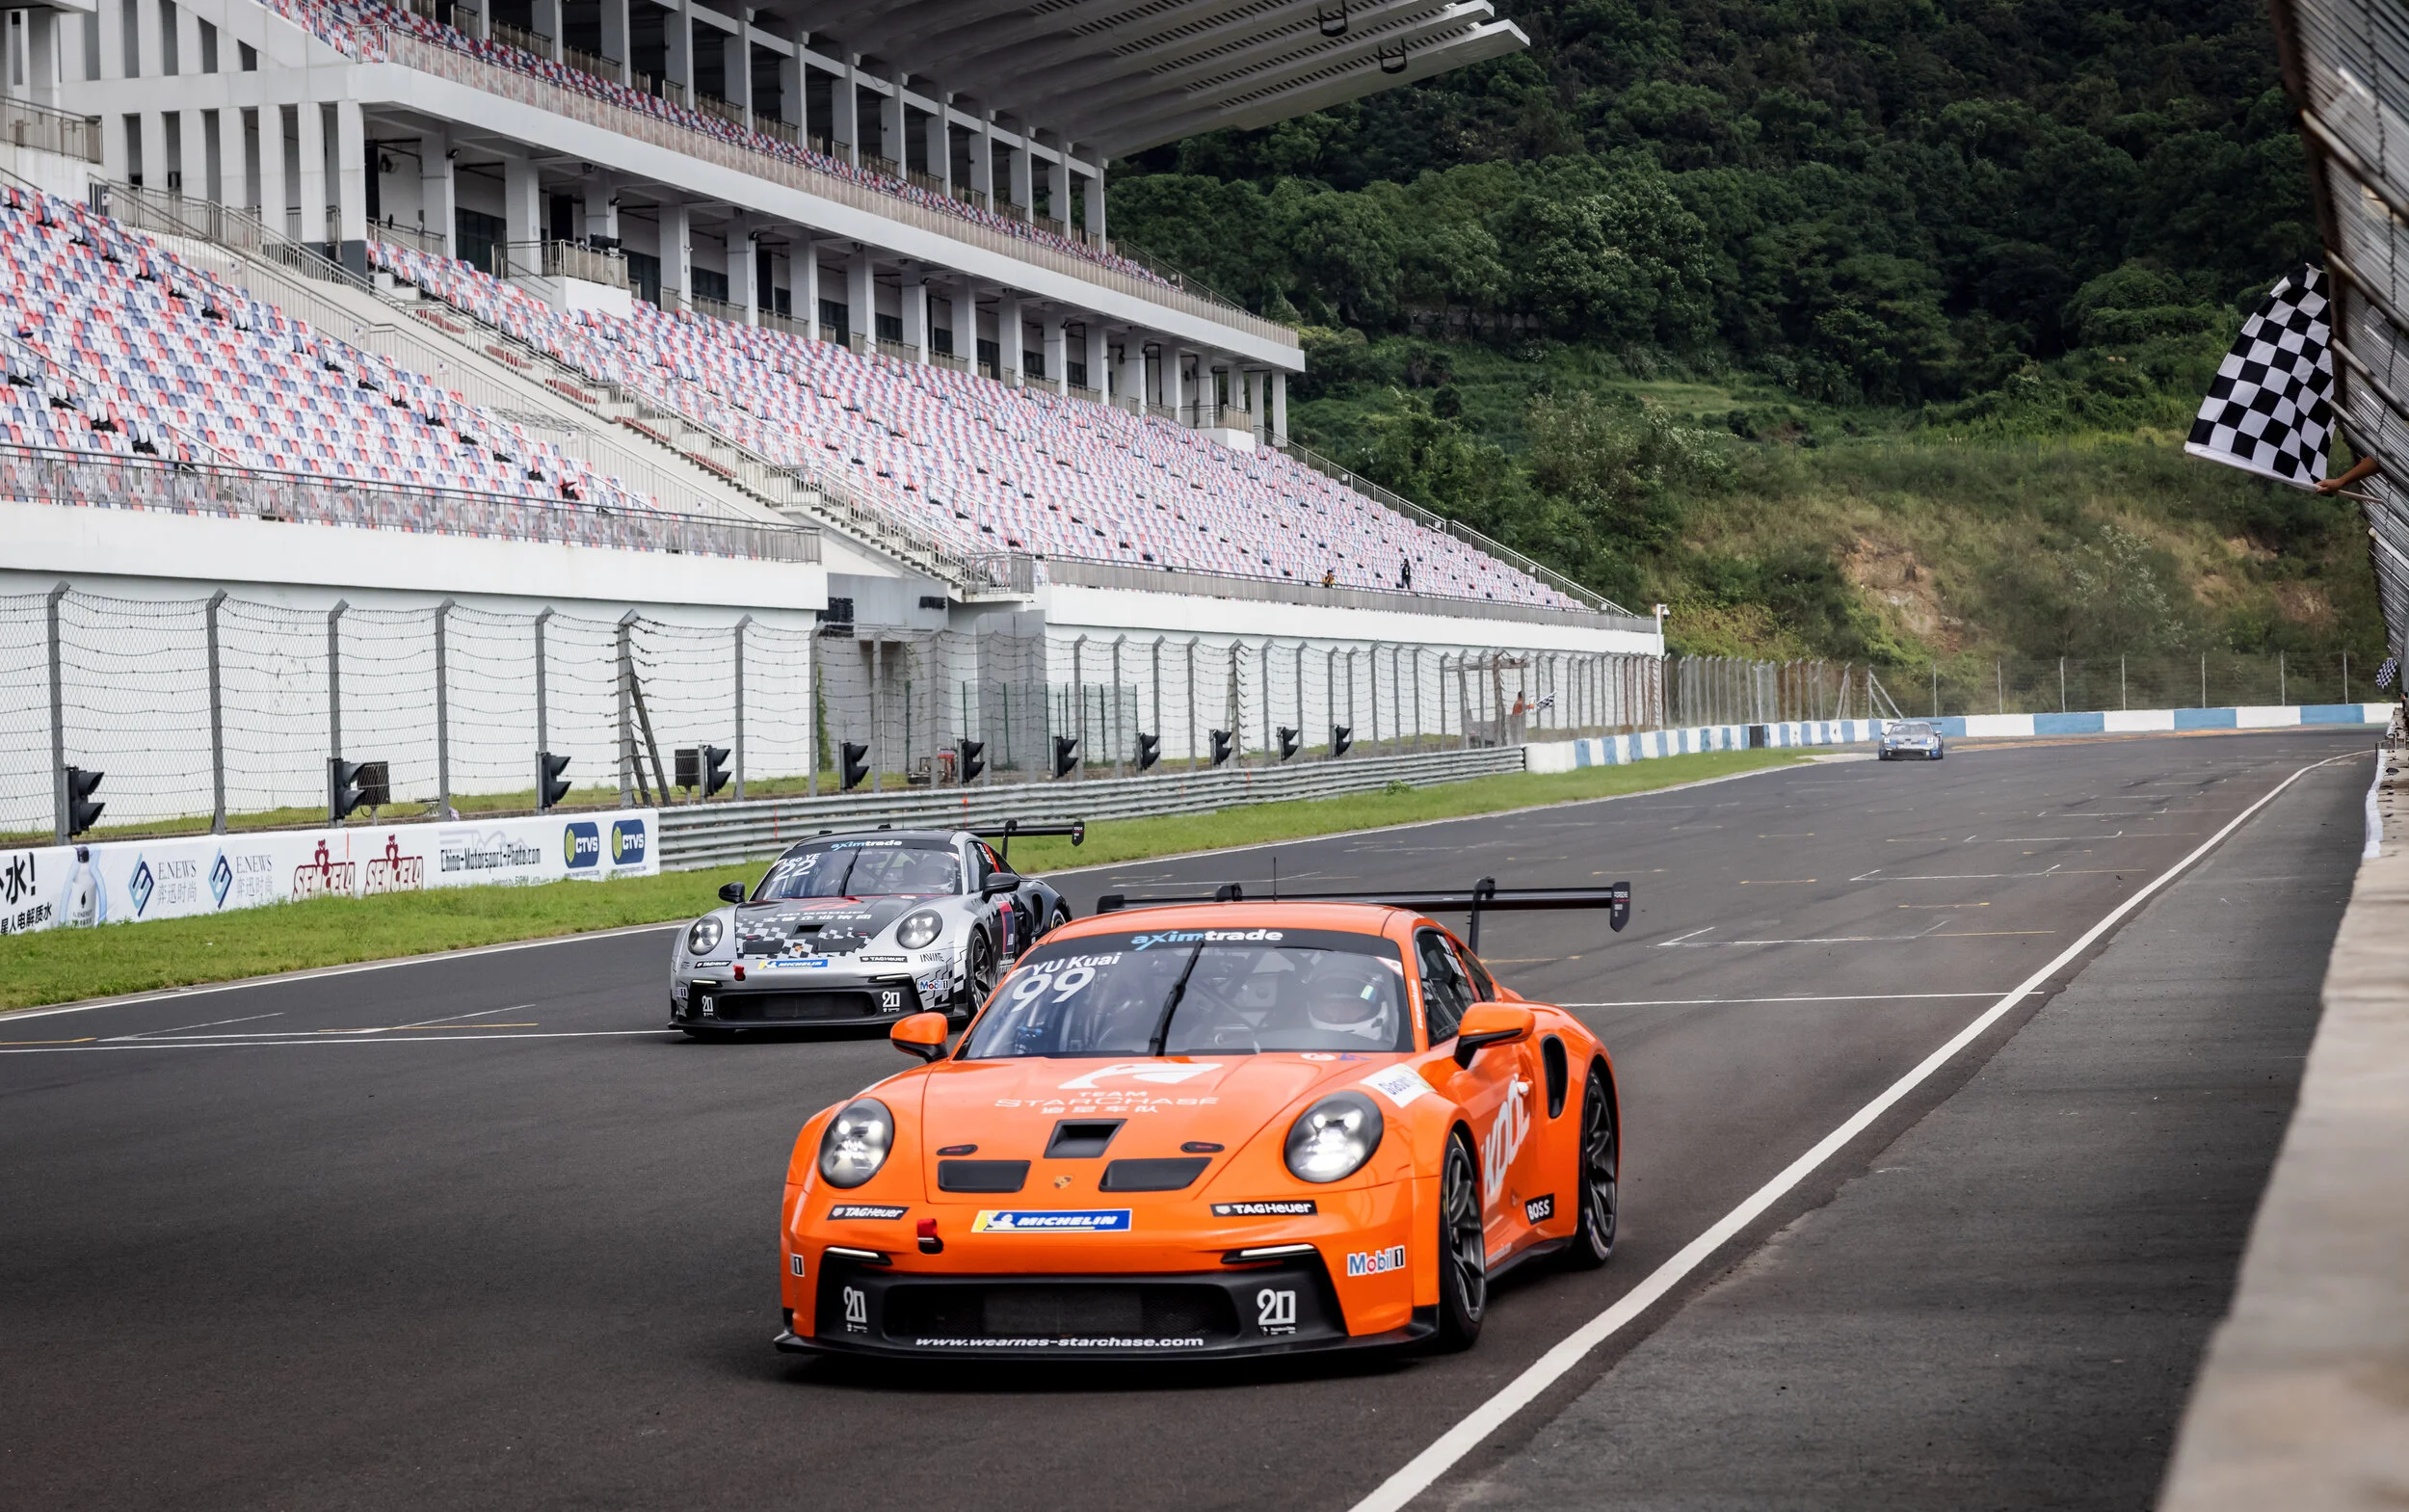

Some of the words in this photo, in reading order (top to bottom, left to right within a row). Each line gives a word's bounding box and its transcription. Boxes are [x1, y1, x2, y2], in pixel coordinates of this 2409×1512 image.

[575, 836, 598, 853] CTVS
[622, 834, 644, 850] CTVS
[831, 839, 903, 852] aximtrade
[158, 860, 197, 881] E.NEWS
[236, 855, 273, 874] E.NEWS
[773, 860, 816, 882] 22
[0, 852, 36, 905] 水!
[1131, 929, 1284, 951] aximtrade
[1033, 959, 1066, 976] YU
[1066, 952, 1123, 969] Kuai
[1011, 967, 1096, 1013] 99
[1018, 1214, 1119, 1227] MICHELIN
[1527, 1199, 1550, 1221] BOSS
[1348, 1250, 1391, 1275] Mobil
[915, 1335, 1204, 1347] www.wearnes-starchase.com
